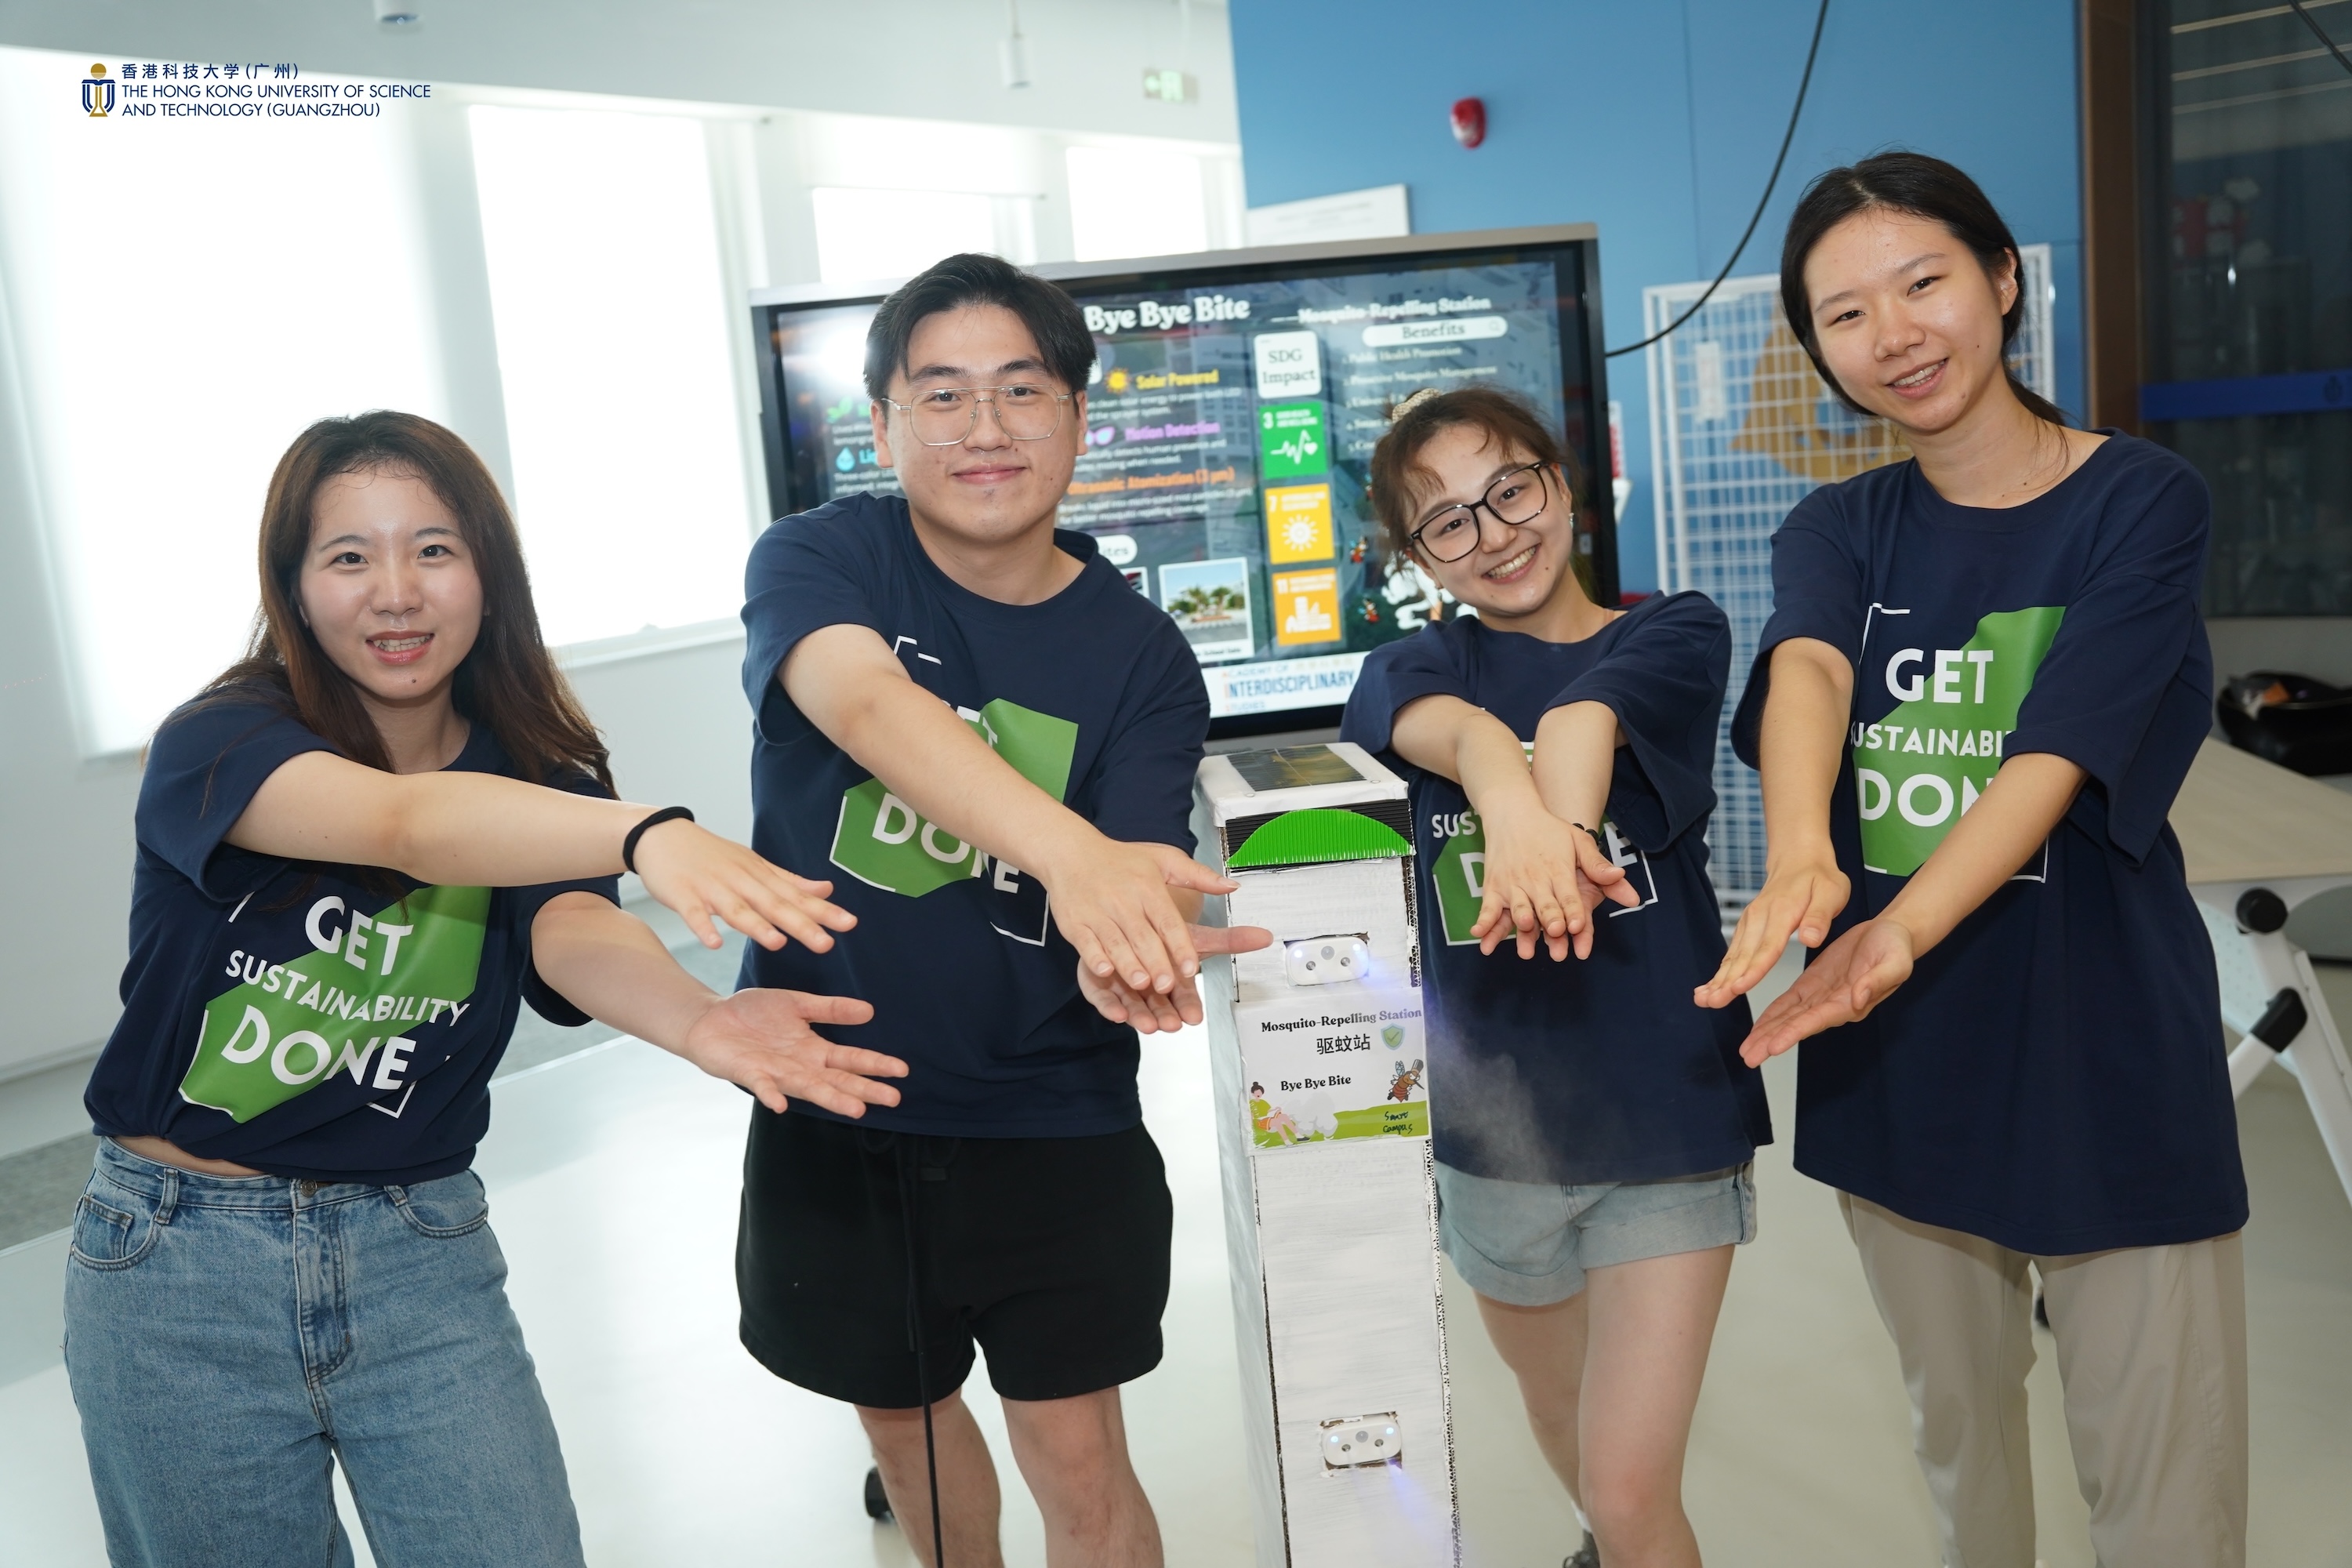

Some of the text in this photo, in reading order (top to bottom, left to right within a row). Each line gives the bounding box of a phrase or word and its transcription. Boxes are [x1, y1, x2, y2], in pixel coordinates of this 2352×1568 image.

[1083, 295, 1251, 335] Bye Bye Bite
[1438, 296, 1491, 313] Station
[1402, 323, 1465, 339] Benefits
[1268, 349, 1303, 363] SDG
[1262, 370, 1316, 387] Impact
[1263, 412, 1274, 430] 3
[1268, 495, 1278, 513] 7
[1276, 578, 1288, 594] 11
[1224, 670, 1355, 699] INTERDISCIPLINARY
[1886, 648, 1994, 704] GET
[1851, 720, 2013, 757] USTAINABI
[1858, 768, 1996, 827] DON
[305, 895, 414, 975] GET
[225, 950, 470, 1027] SUSTAINABILITY
[1261, 1008, 1422, 1033] Mosquito-Repelling Station
[220, 1004, 417, 1090] DONE
[1316, 1033, 1370, 1054] 驱蚊站
[1280, 1075, 1352, 1092] Bye Bye Bite
